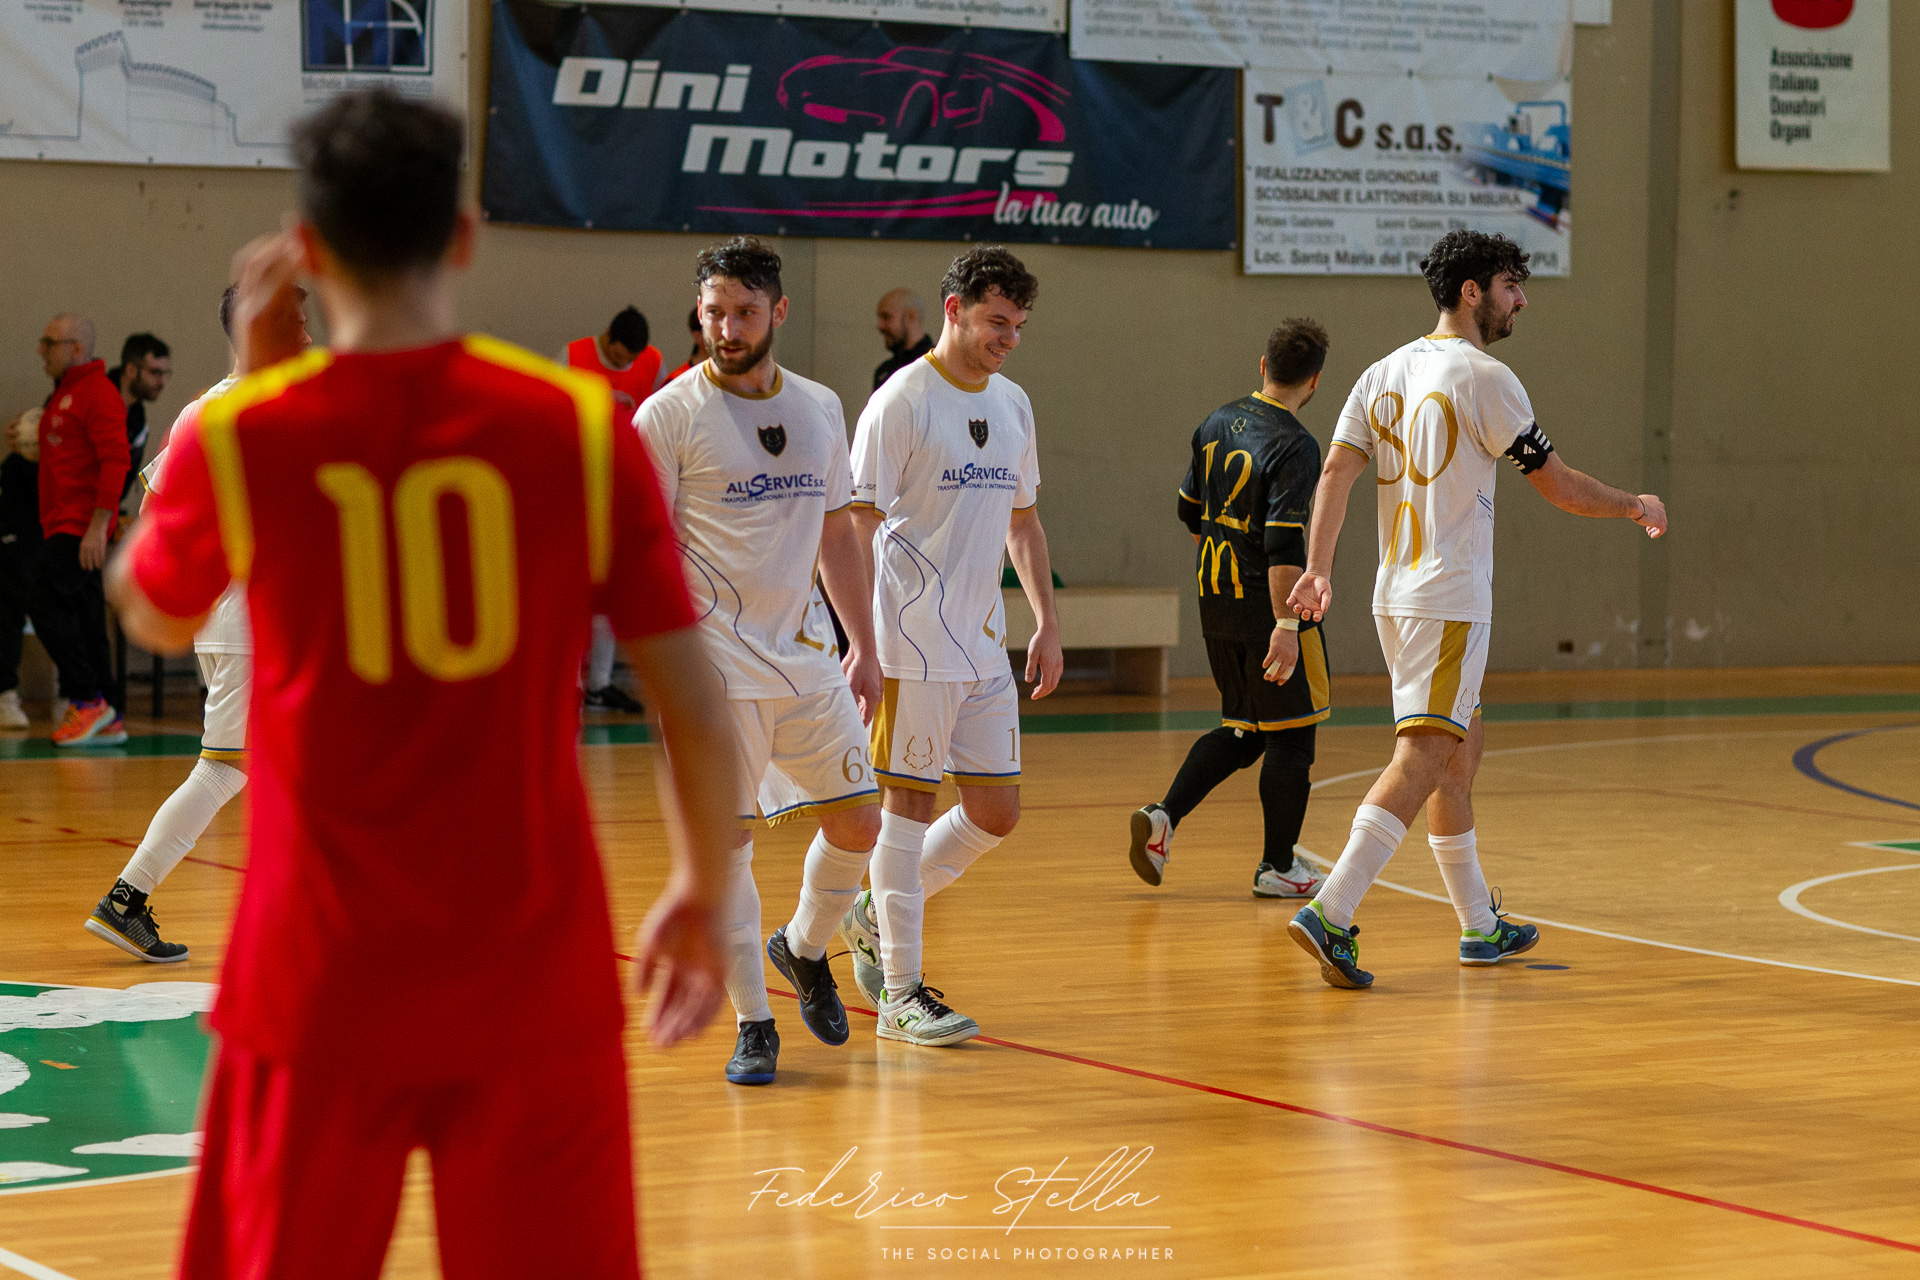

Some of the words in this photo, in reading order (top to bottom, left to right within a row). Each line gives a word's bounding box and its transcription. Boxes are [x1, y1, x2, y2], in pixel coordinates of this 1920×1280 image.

[1770, 47, 1854, 70] Associazione
[552, 56, 752, 113] Dini
[1769, 74, 1820, 92] Italiana
[681, 123, 1075, 188] Motors
[1375, 122, 1463, 153] s.a.s.
[1255, 167, 1361, 185] REALIZZAZIONE
[1365, 170, 1441, 186] GRONDAIE
[1255, 186, 1342, 204] SCOSSALINE
[1344, 188, 1353, 203] E
[1356, 187, 1445, 205] LATTONERIA
[1448, 189, 1466, 205] SU
[1469, 189, 1521, 206] MISURA
[994, 182, 1028, 225] la
[1030, 193, 1089, 227] tua
[1092, 197, 1159, 231] auto
[1290, 249, 1330, 267] Santa
[1335, 250, 1375, 268] Maria
[1369, 390, 1459, 487] 80
[1200, 439, 1254, 535] 12
[315, 455, 521, 685] 10
